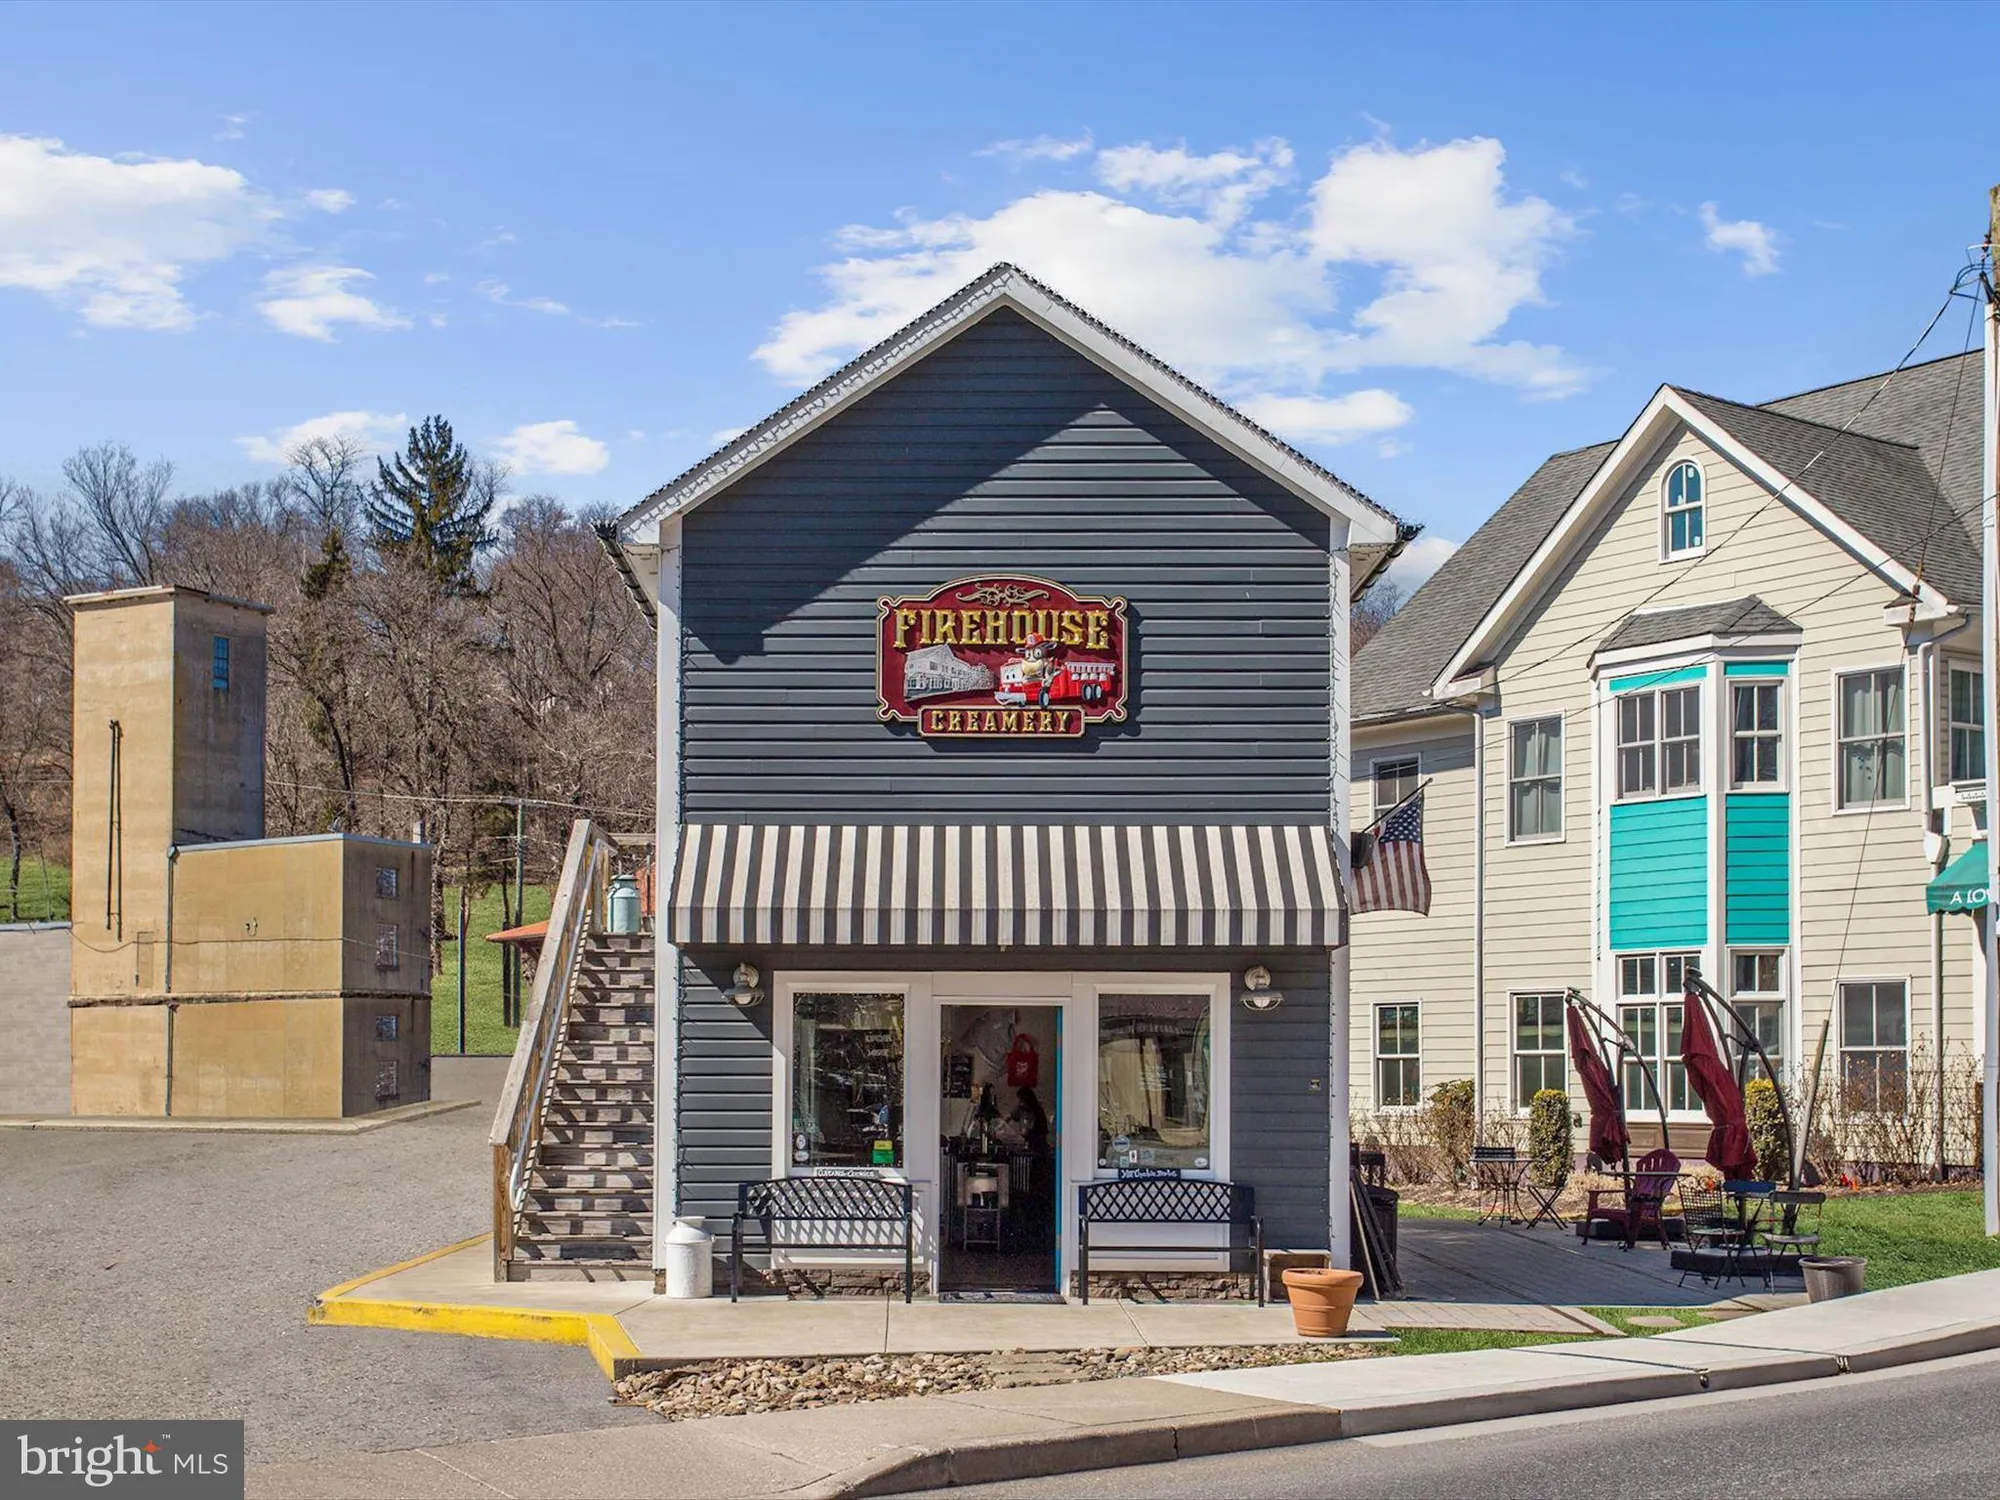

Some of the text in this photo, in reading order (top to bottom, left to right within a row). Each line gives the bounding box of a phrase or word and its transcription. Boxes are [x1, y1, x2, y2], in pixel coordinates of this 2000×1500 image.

[893, 608, 1110, 649] FIREHOUSE
[931, 709, 1070, 732] CREAMERY
[1950, 890, 1962, 905] A
